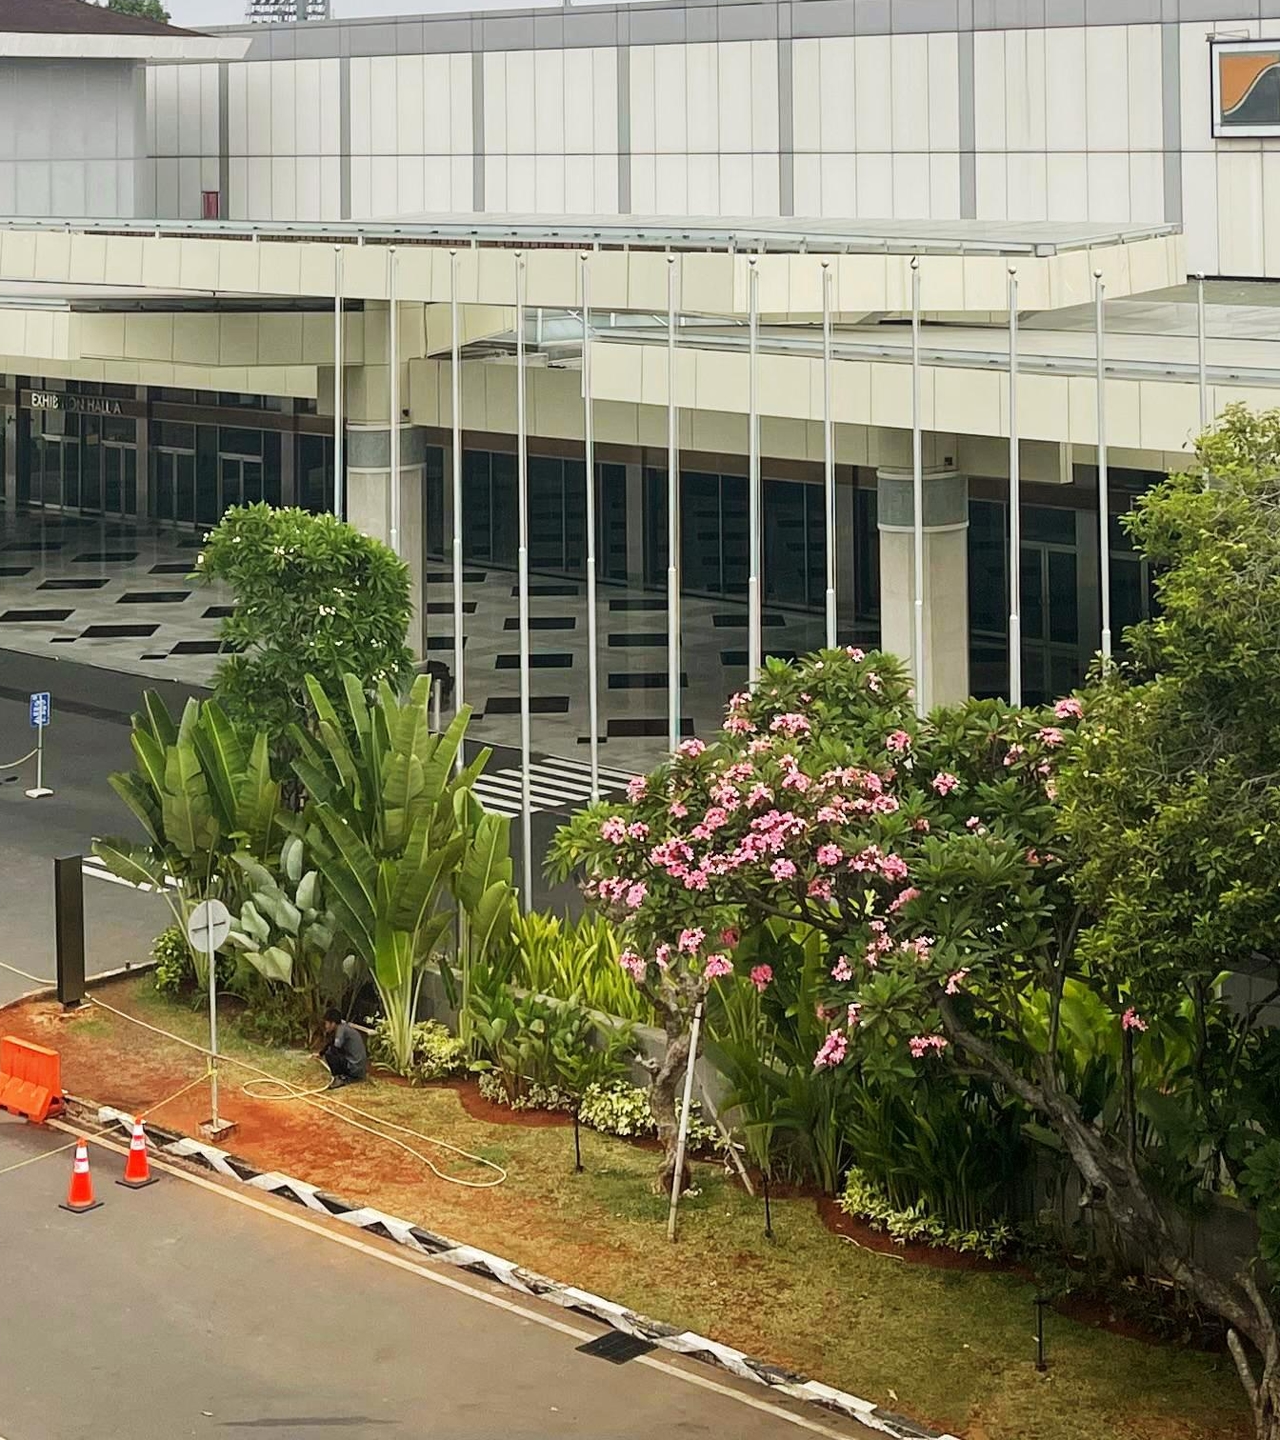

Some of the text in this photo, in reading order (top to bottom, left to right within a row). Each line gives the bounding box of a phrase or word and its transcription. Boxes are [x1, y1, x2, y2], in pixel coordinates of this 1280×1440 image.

[31, 393, 122, 415] EXHIBON HALL A
